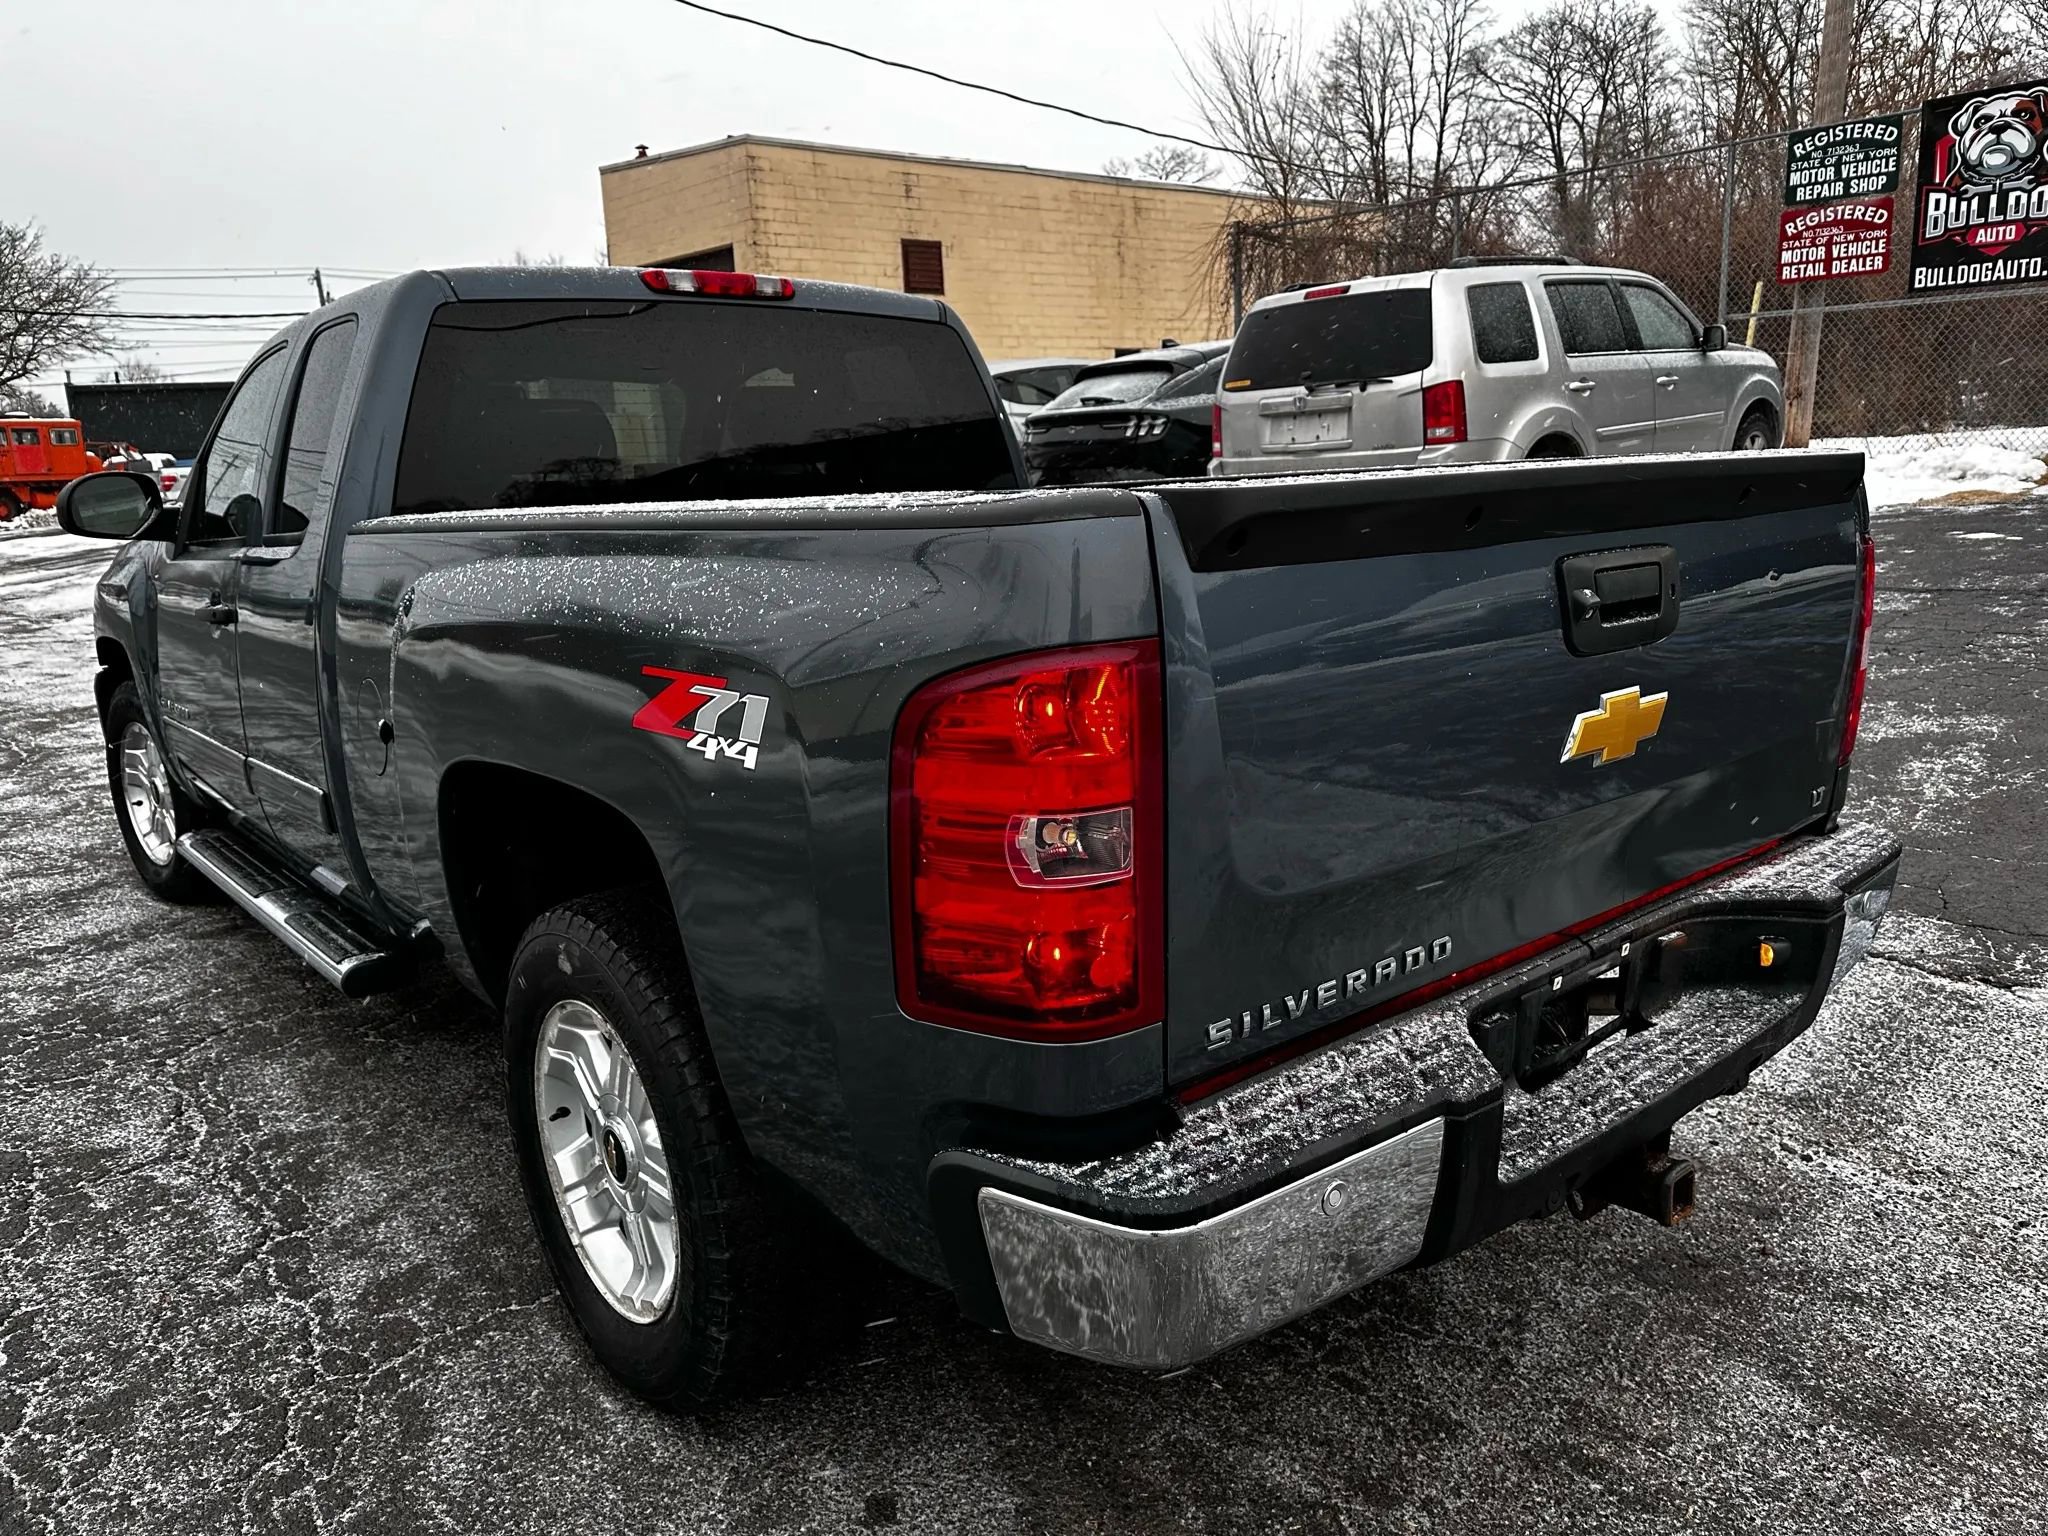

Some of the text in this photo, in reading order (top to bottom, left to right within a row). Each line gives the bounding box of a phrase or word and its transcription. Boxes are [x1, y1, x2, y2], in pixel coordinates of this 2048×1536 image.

[1793, 123, 1898, 158] REGISTERED
[1827, 143, 1860, 156] 7132363
[1789, 157, 1897, 186] MOTOR VEHICLE
[1790, 147, 1898, 171] STATE OF NEW YORK
[1796, 175, 1887, 201] REPAIR SHOP
[1784, 205, 1888, 237] REGISTERED
[1782, 229, 1888, 249] STATE OF NEW YORK
[1975, 225, 2016, 243] AUTO
[1781, 239, 1887, 264] MOTOR VEHICLE
[1782, 256, 1883, 280] RETAIL DEALER
[632, 665, 769, 744] Z71
[1206, 935, 1452, 1051] SILVERADO
